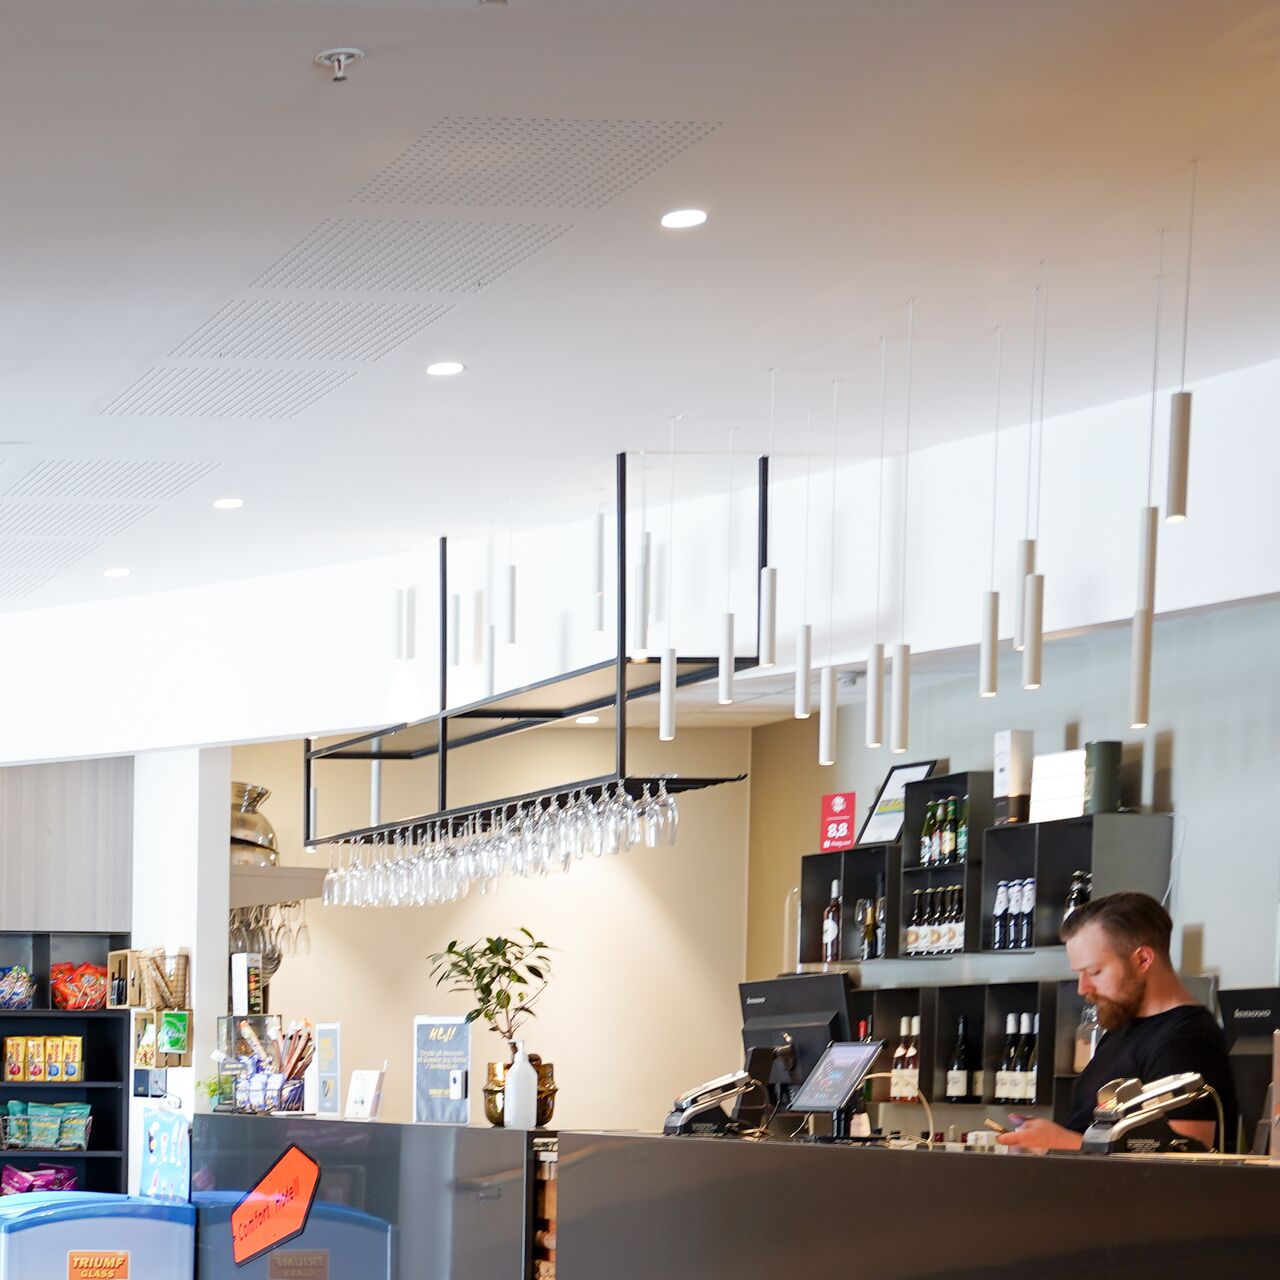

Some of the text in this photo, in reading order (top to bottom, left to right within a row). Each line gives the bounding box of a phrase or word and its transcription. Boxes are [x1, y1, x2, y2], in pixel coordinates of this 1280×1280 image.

[1233, 1009, 1271, 1018] lenovo
[238, 1201, 270, 1241] Comfort
[72, 1256, 125, 1269] TRIUMF
[80, 1269, 116, 1279] GLASS
